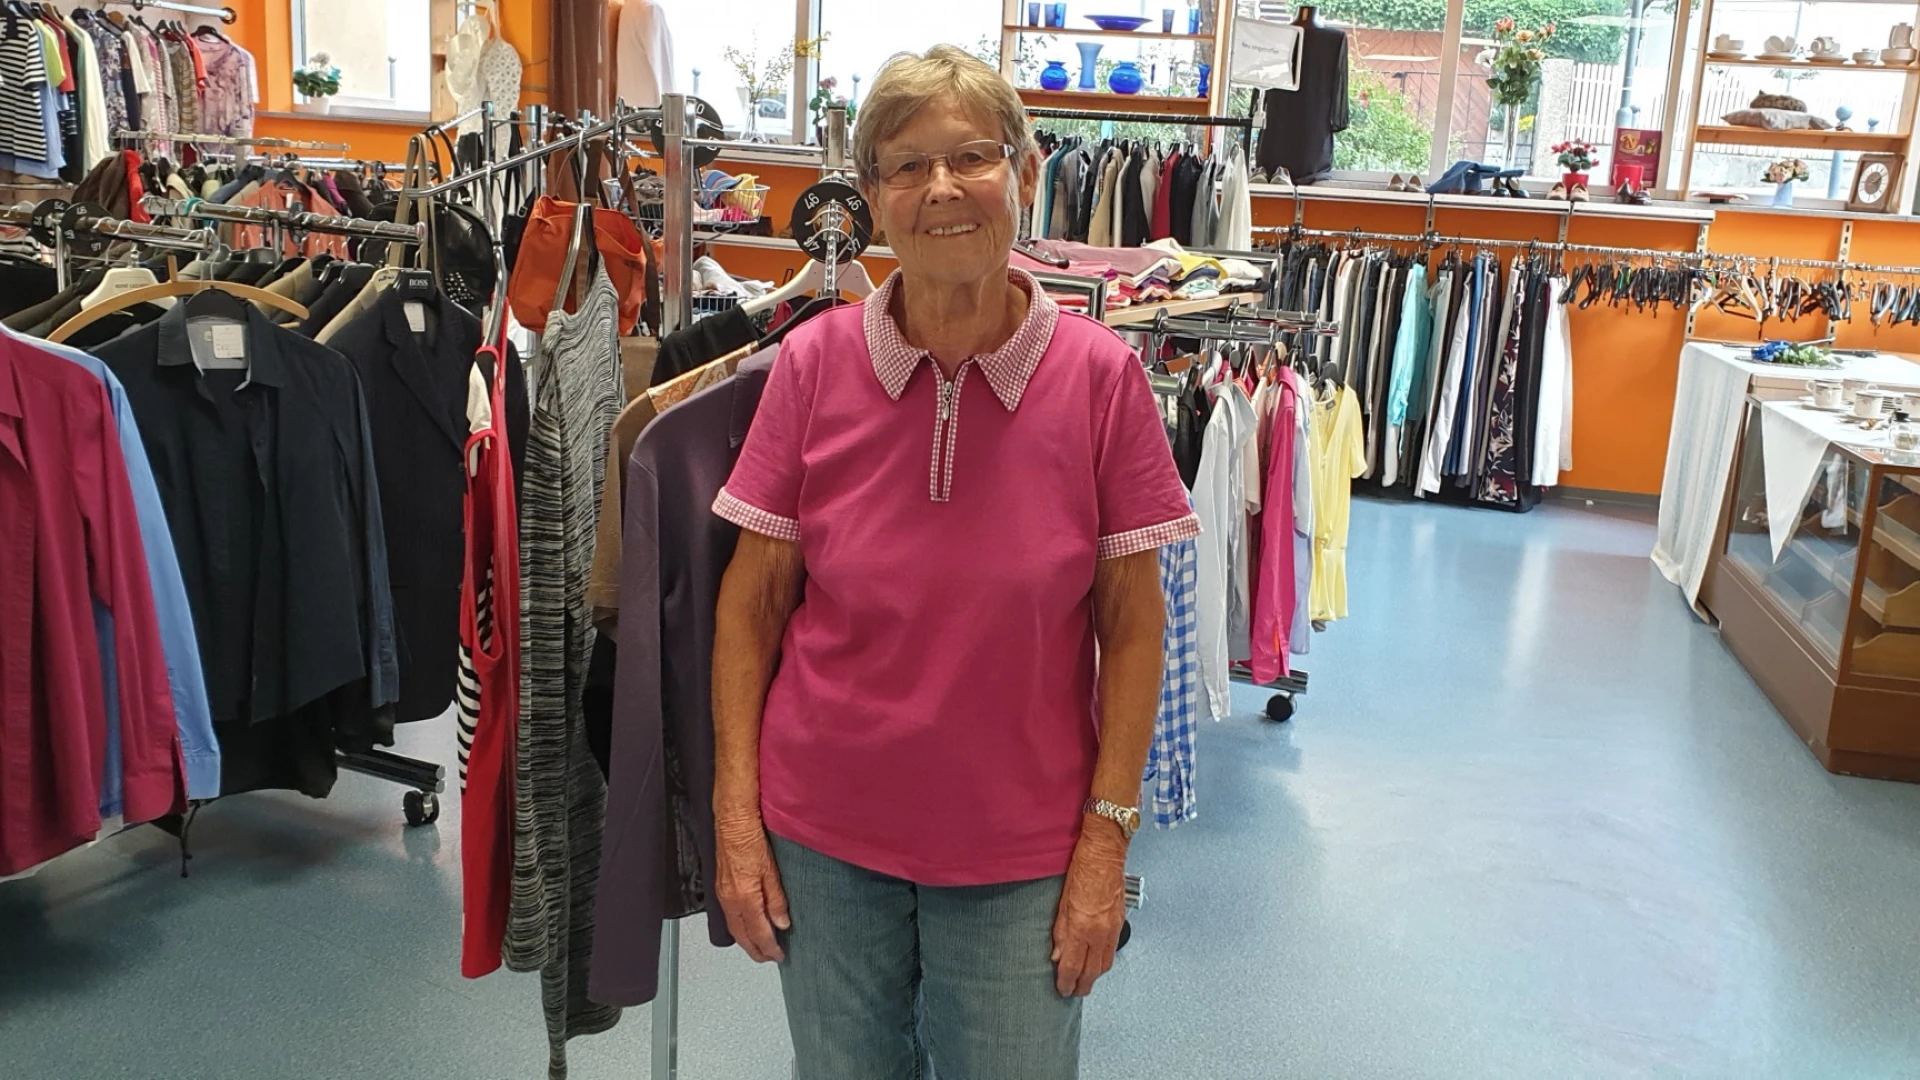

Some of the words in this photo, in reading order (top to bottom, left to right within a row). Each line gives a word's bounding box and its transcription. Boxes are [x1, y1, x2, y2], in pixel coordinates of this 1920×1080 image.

[696, 103, 705, 115] 0
[803, 192, 820, 210] 46
[845, 195, 862, 211] 46
